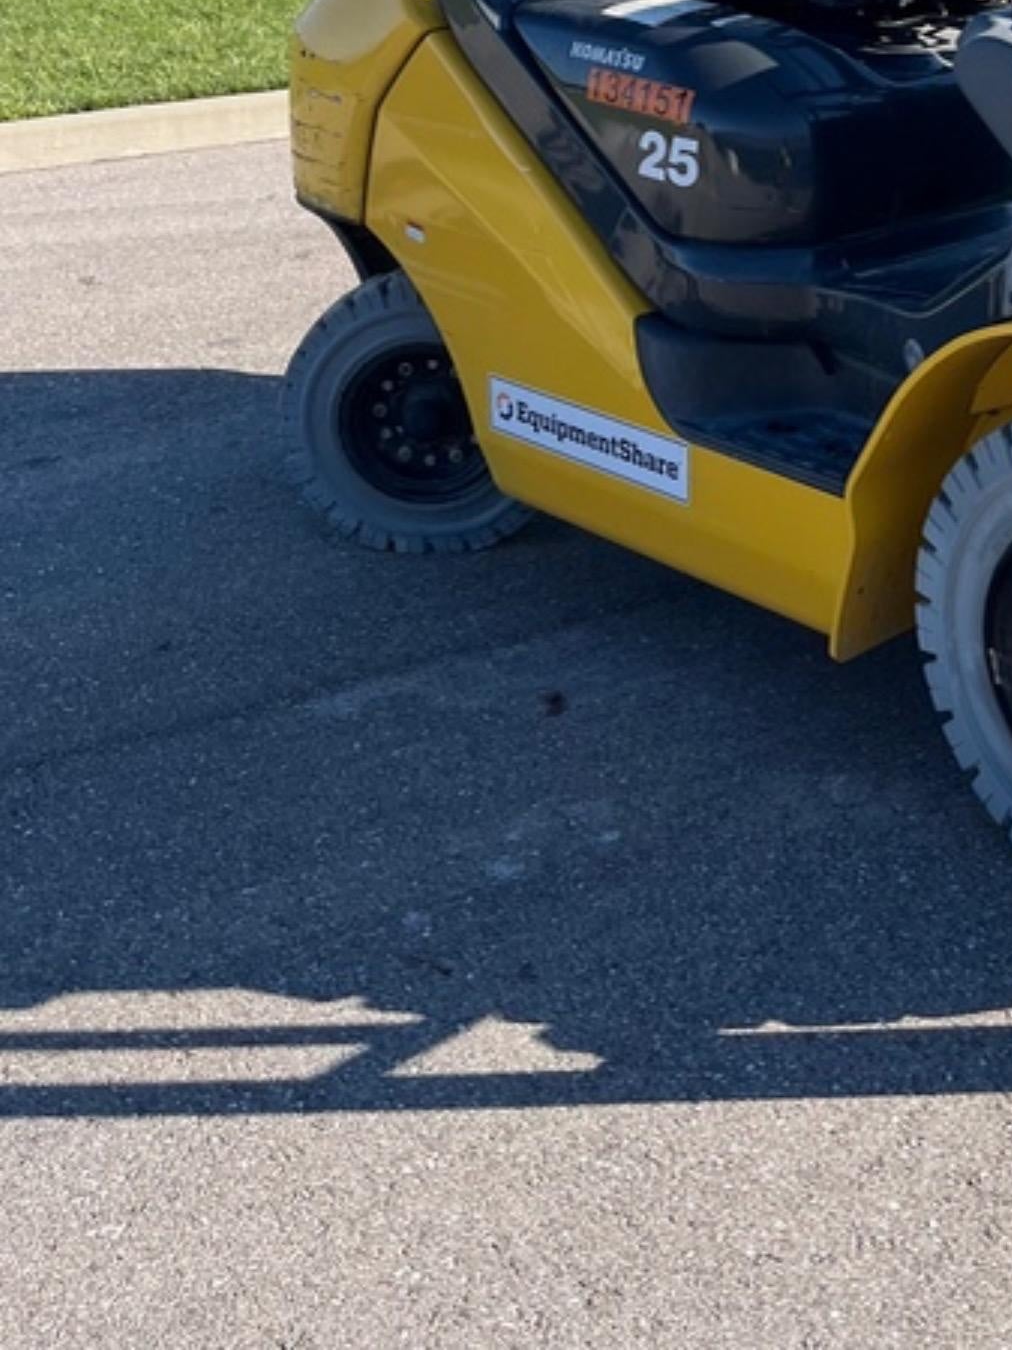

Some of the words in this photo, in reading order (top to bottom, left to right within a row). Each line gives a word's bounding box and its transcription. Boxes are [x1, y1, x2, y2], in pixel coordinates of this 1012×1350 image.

[569, 41, 646, 71] KOMATSU
[638, 129, 699, 187] 25
[516, 401, 680, 480] EquipmentShare
